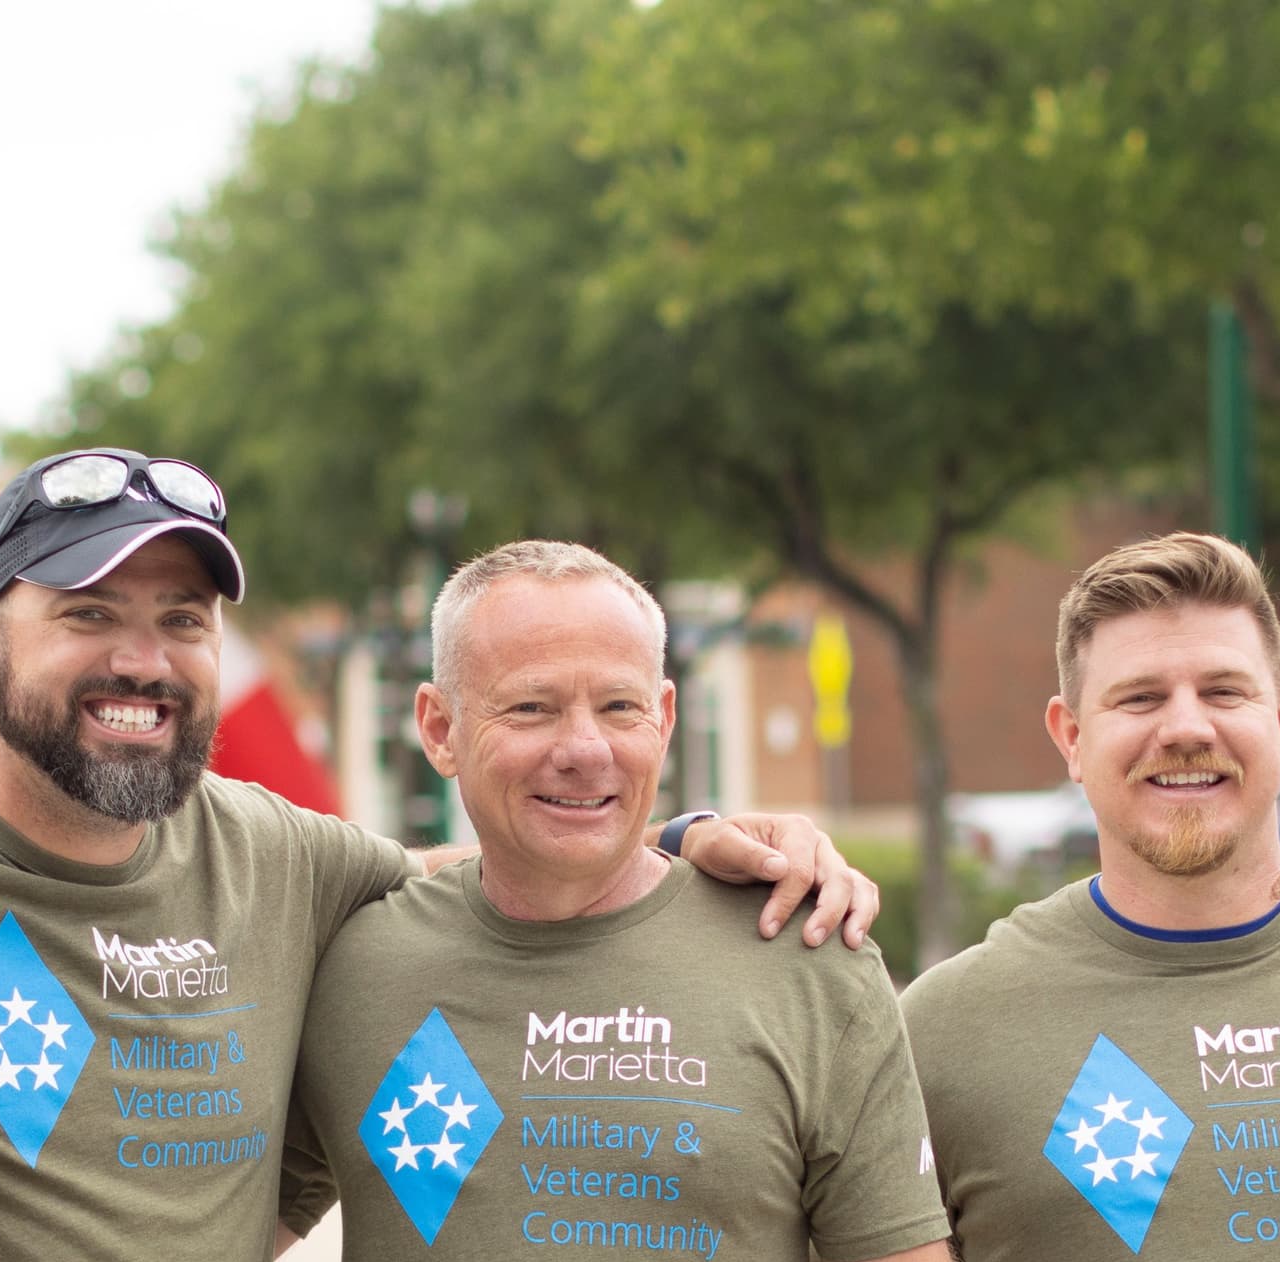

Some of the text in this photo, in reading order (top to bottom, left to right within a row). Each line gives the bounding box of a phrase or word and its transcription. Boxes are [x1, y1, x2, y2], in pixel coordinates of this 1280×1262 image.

[92, 926, 217, 967] Martin
[102, 957, 229, 1000] Marietta
[526, 1005, 672, 1046] Martin
[109, 1029, 247, 1076] Military &
[522, 1046, 707, 1087] Marietta
[113, 1086, 244, 1120] Veterans
[522, 1115, 702, 1157] Military &
[521, 1163, 681, 1201] Veterans
[522, 1211, 724, 1261] Community
